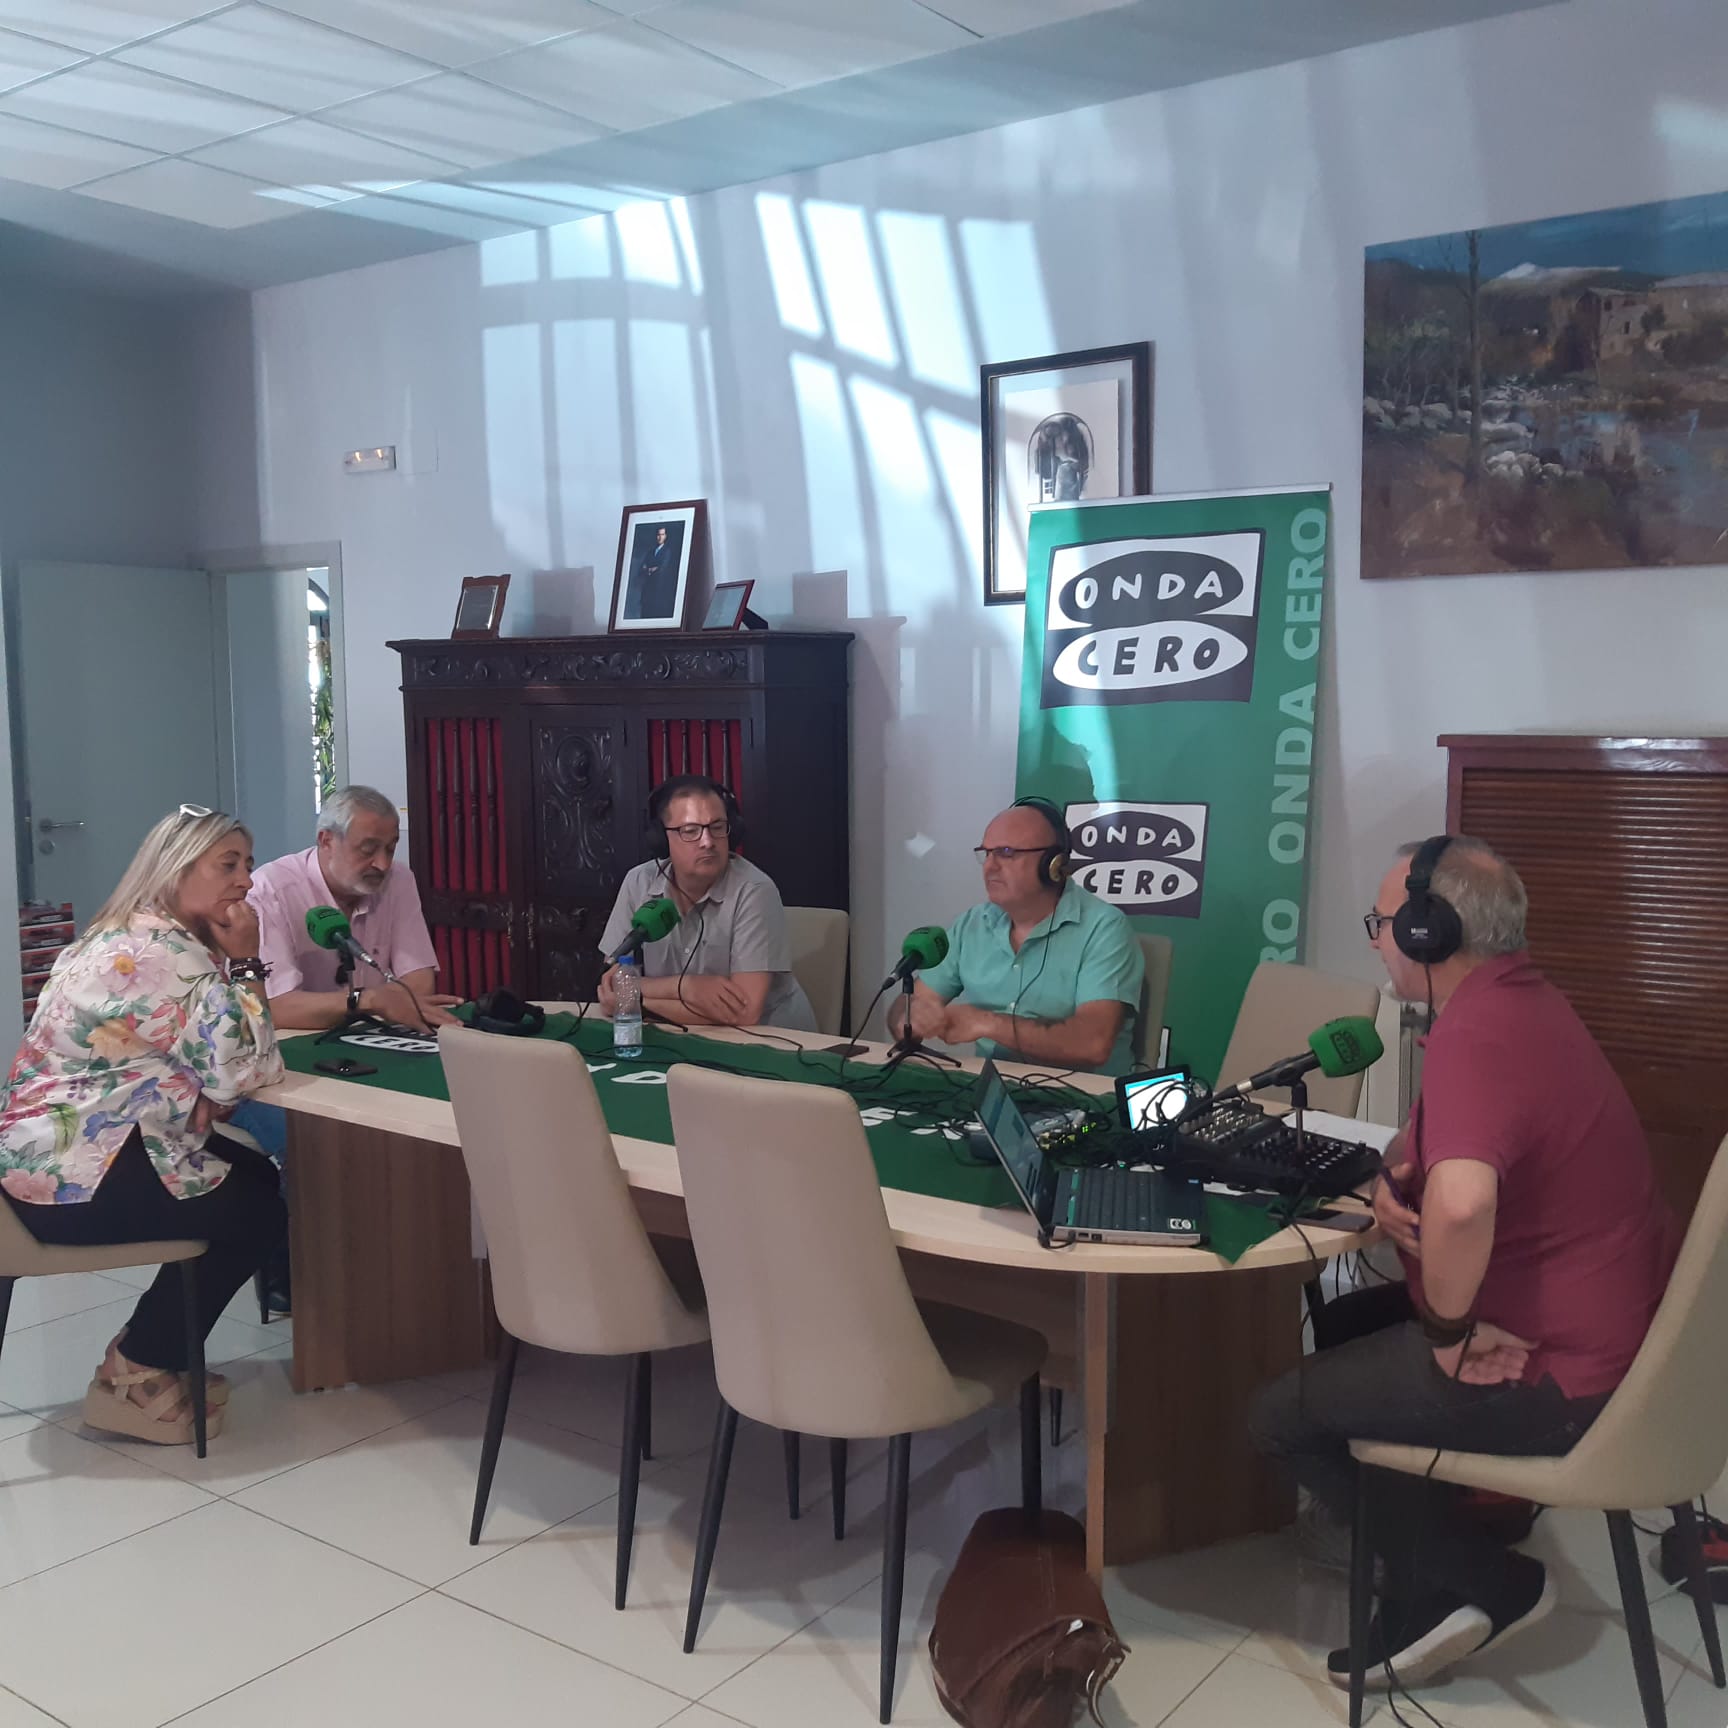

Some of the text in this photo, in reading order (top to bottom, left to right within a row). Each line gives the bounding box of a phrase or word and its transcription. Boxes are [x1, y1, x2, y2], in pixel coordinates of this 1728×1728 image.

[1074, 570, 1224, 610] ONDA
[1078, 637, 1220, 676] CERO
[1268, 507, 1327, 864] ONDA CERO
[1080, 825, 1183, 849] ONDA
[1084, 870, 1180, 895] CERO
[1259, 898, 1299, 963] RO
